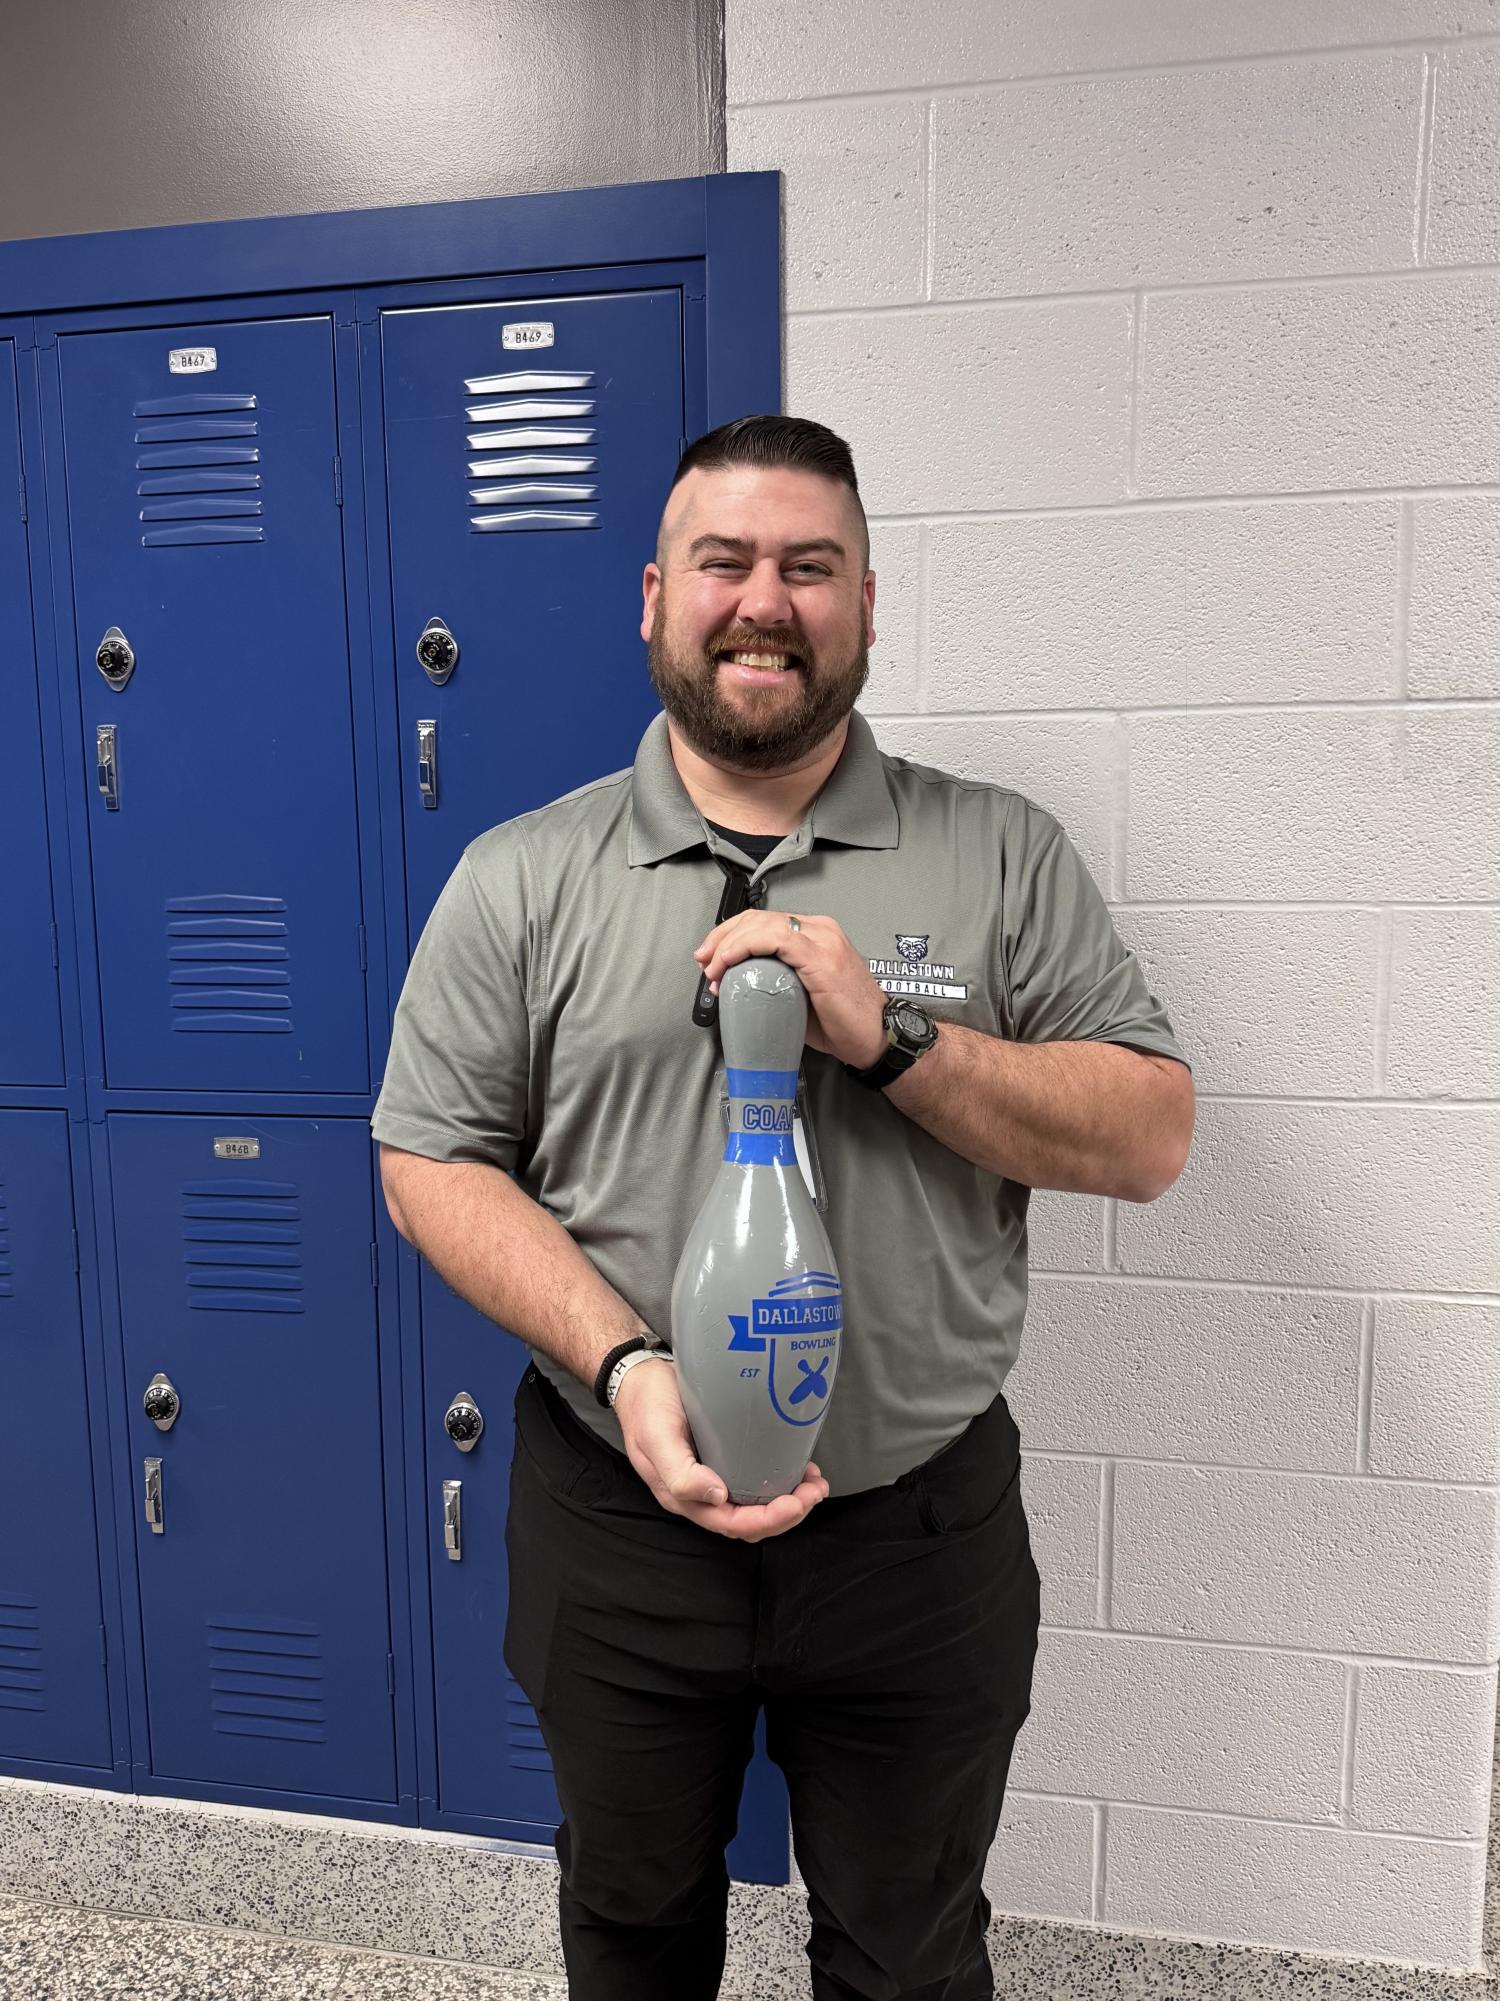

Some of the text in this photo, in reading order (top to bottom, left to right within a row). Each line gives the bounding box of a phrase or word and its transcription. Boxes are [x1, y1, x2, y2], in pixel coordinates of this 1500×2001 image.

[515, 332, 541, 344] B469
[181, 353, 204, 367] B467
[869, 959, 954, 980] DALLASTOWN
[790, 1336, 836, 1350] BOWLING
[740, 1368, 760, 1378] EST
